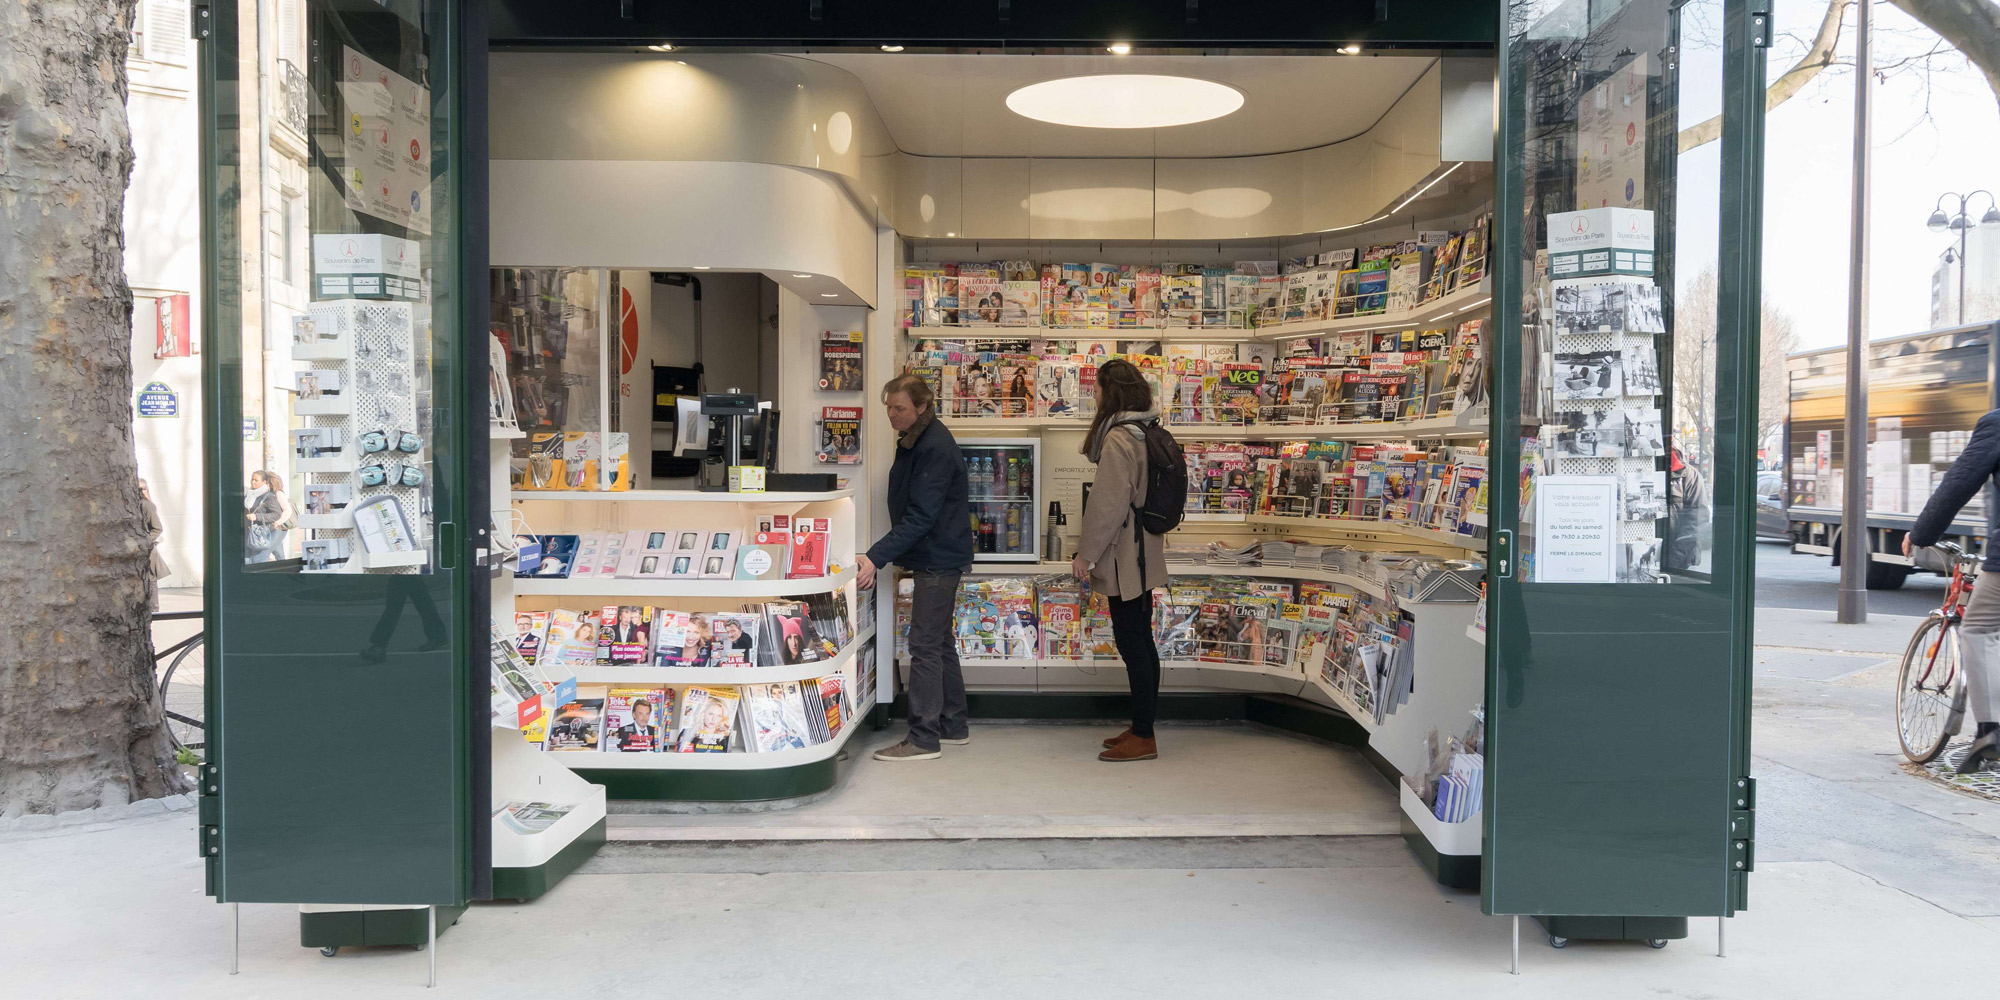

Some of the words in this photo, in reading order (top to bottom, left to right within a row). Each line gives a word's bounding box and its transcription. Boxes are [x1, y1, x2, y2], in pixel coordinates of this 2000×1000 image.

[996, 261, 1032, 272] YOGA
[1360, 262, 1374, 272] GEO
[1228, 370, 1259, 384] VeG
[826, 408, 857, 418] Marianne
[1309, 443, 1342, 452] fisheye
[1224, 462, 1246, 471] Public
[1236, 606, 1267, 617] Cheval
[1308, 607, 1330, 619] Marianne
[609, 697, 626, 706] Télé
